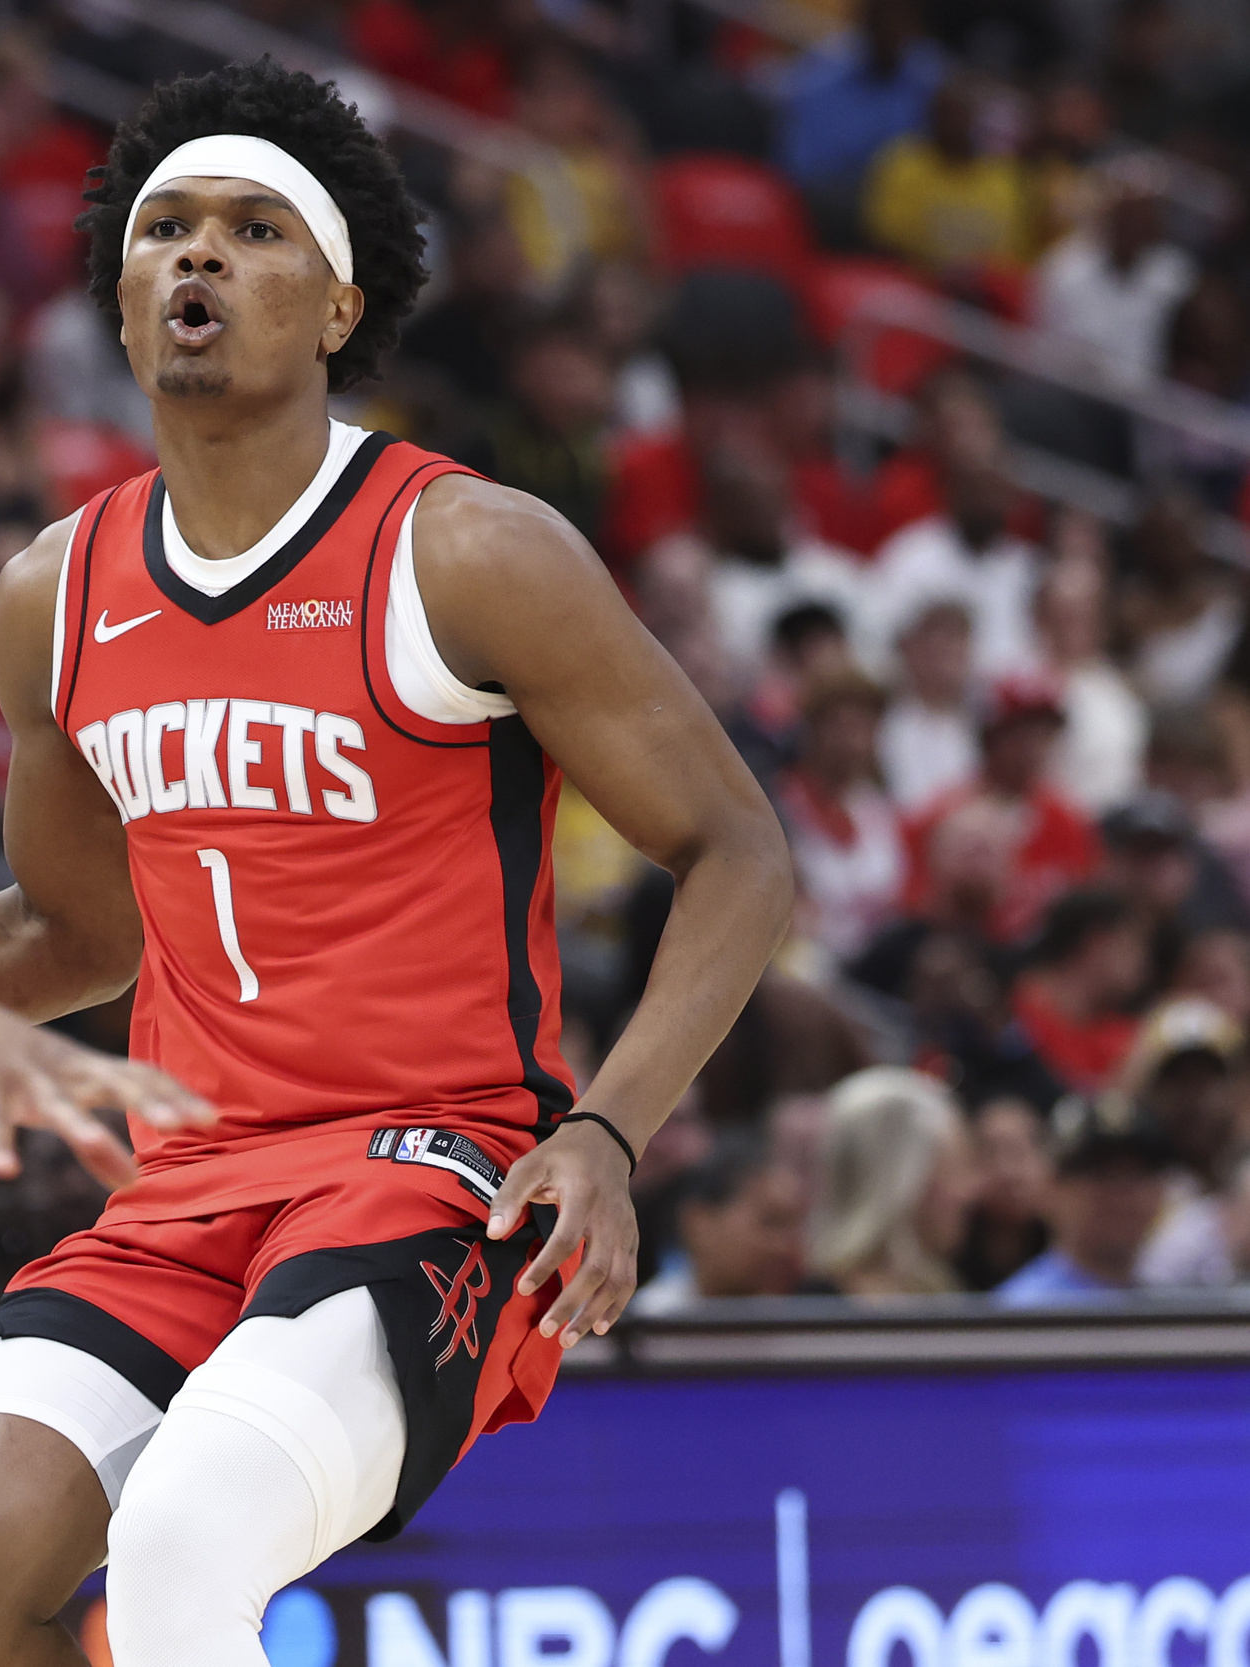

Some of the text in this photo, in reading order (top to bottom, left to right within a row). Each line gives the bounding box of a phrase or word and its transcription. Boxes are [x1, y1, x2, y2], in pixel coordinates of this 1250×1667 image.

[267, 599, 354, 617] MEMORIAL
[266, 613, 353, 630] HERMANN
[76, 698, 378, 826] ROCKETS
[196, 848, 260, 1003] 1
[434, 1138, 449, 1149] 46
